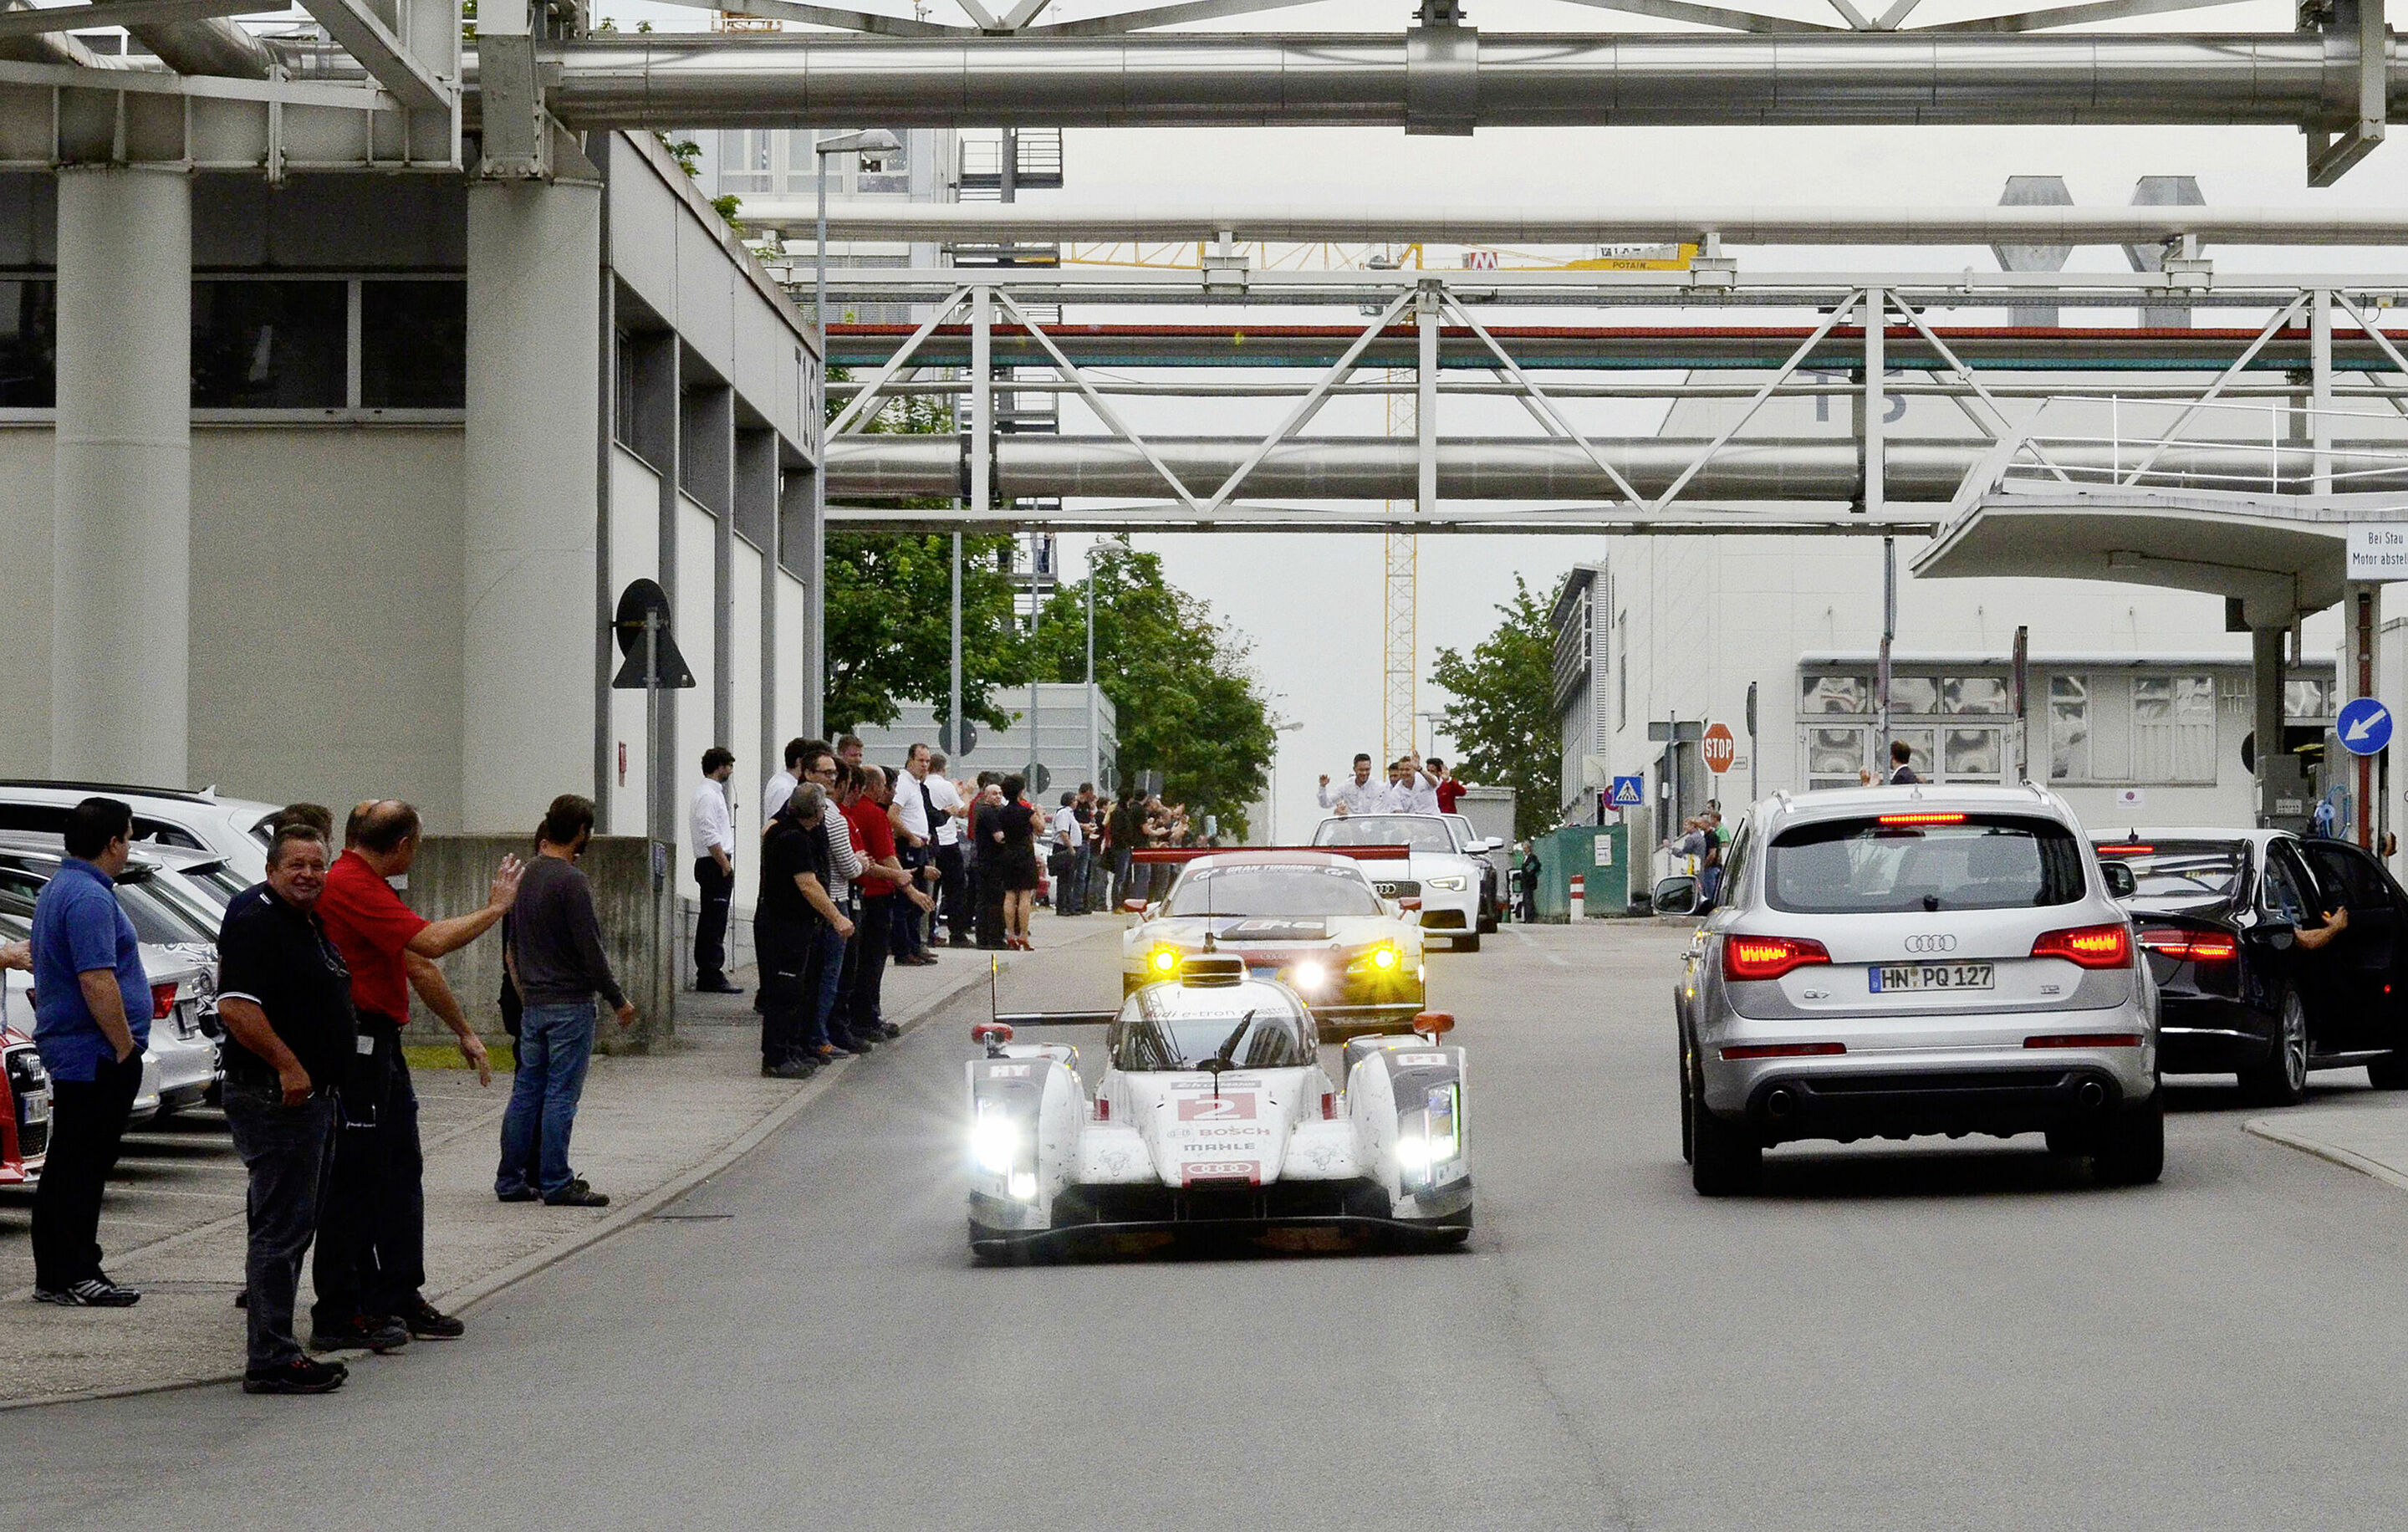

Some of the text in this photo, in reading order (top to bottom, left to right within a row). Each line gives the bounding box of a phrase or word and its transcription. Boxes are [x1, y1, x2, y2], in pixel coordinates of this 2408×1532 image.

[795, 345, 816, 456] T16
[2368, 531, 2403, 544] Bei Stau
[2353, 553, 2408, 565] Motor abstel
[1706, 738, 1732, 758] STOP
[1227, 864, 1316, 873] GRAN TURISMO
[1882, 966, 1991, 988] HN PQ 127
[990, 1065, 1030, 1077] HY
[1193, 1099, 1241, 1120] 2
[1200, 1127, 1270, 1136] BOSCH
